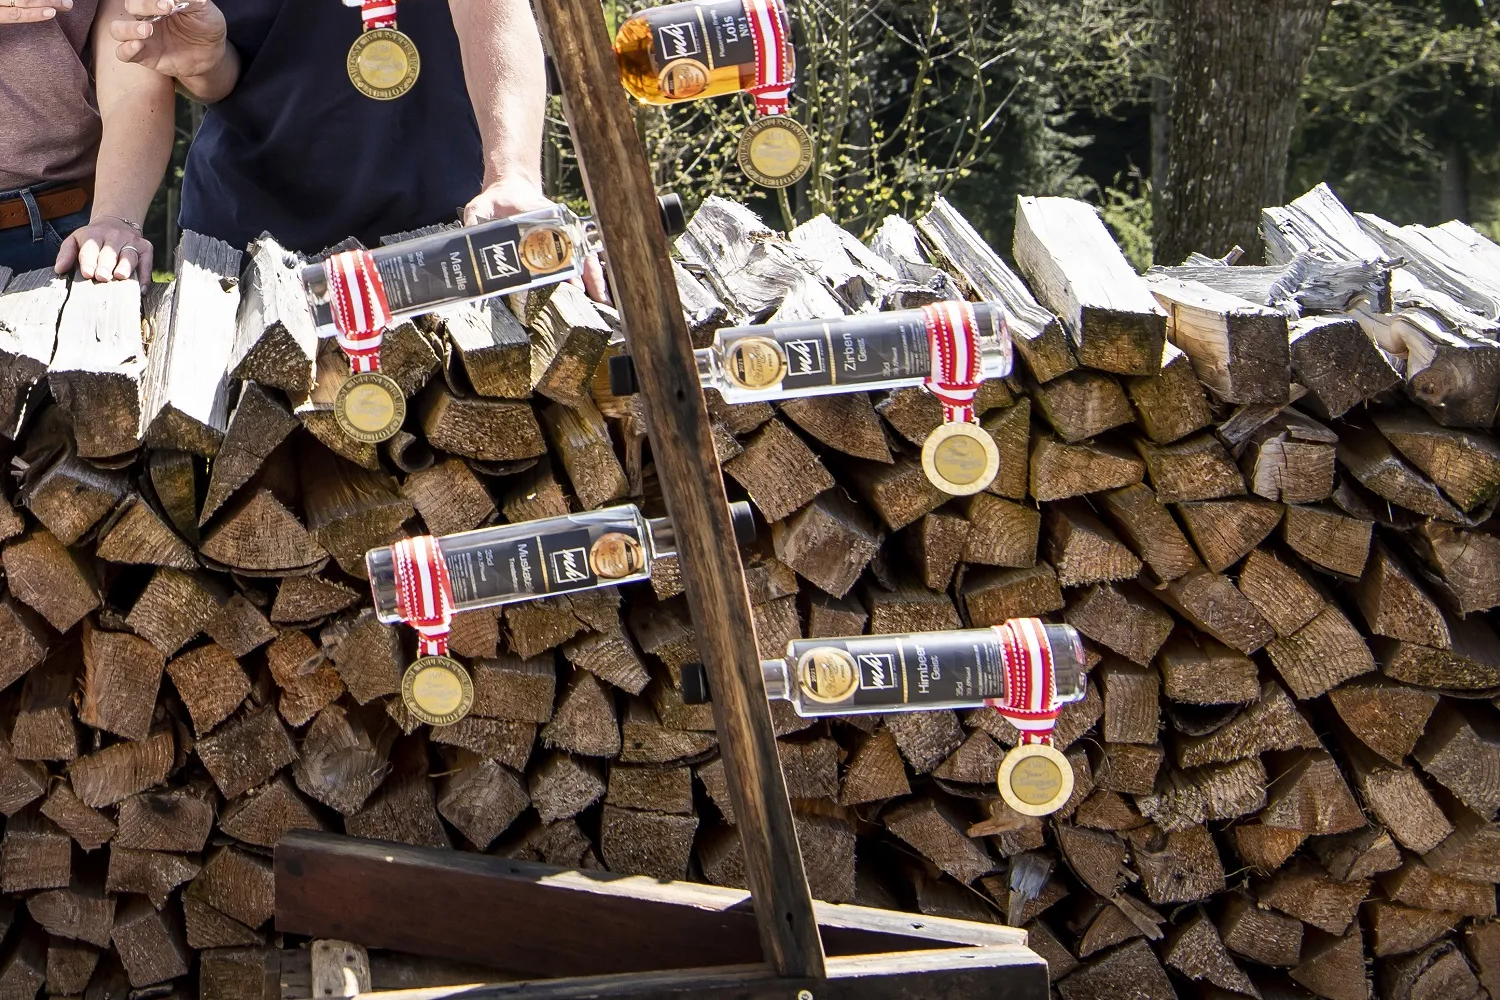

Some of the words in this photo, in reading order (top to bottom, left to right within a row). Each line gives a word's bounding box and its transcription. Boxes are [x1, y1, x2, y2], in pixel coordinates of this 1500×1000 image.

[723, 16, 738, 43] Lois
[415, 251, 424, 266] 35cl
[450, 252, 466, 290] Marille
[843, 333, 856, 371] Zirben
[857, 338, 867, 362] Geist
[485, 549, 494, 566] 35cl
[915, 645, 929, 693] Himbeer
[931, 656, 941, 680] Geist
